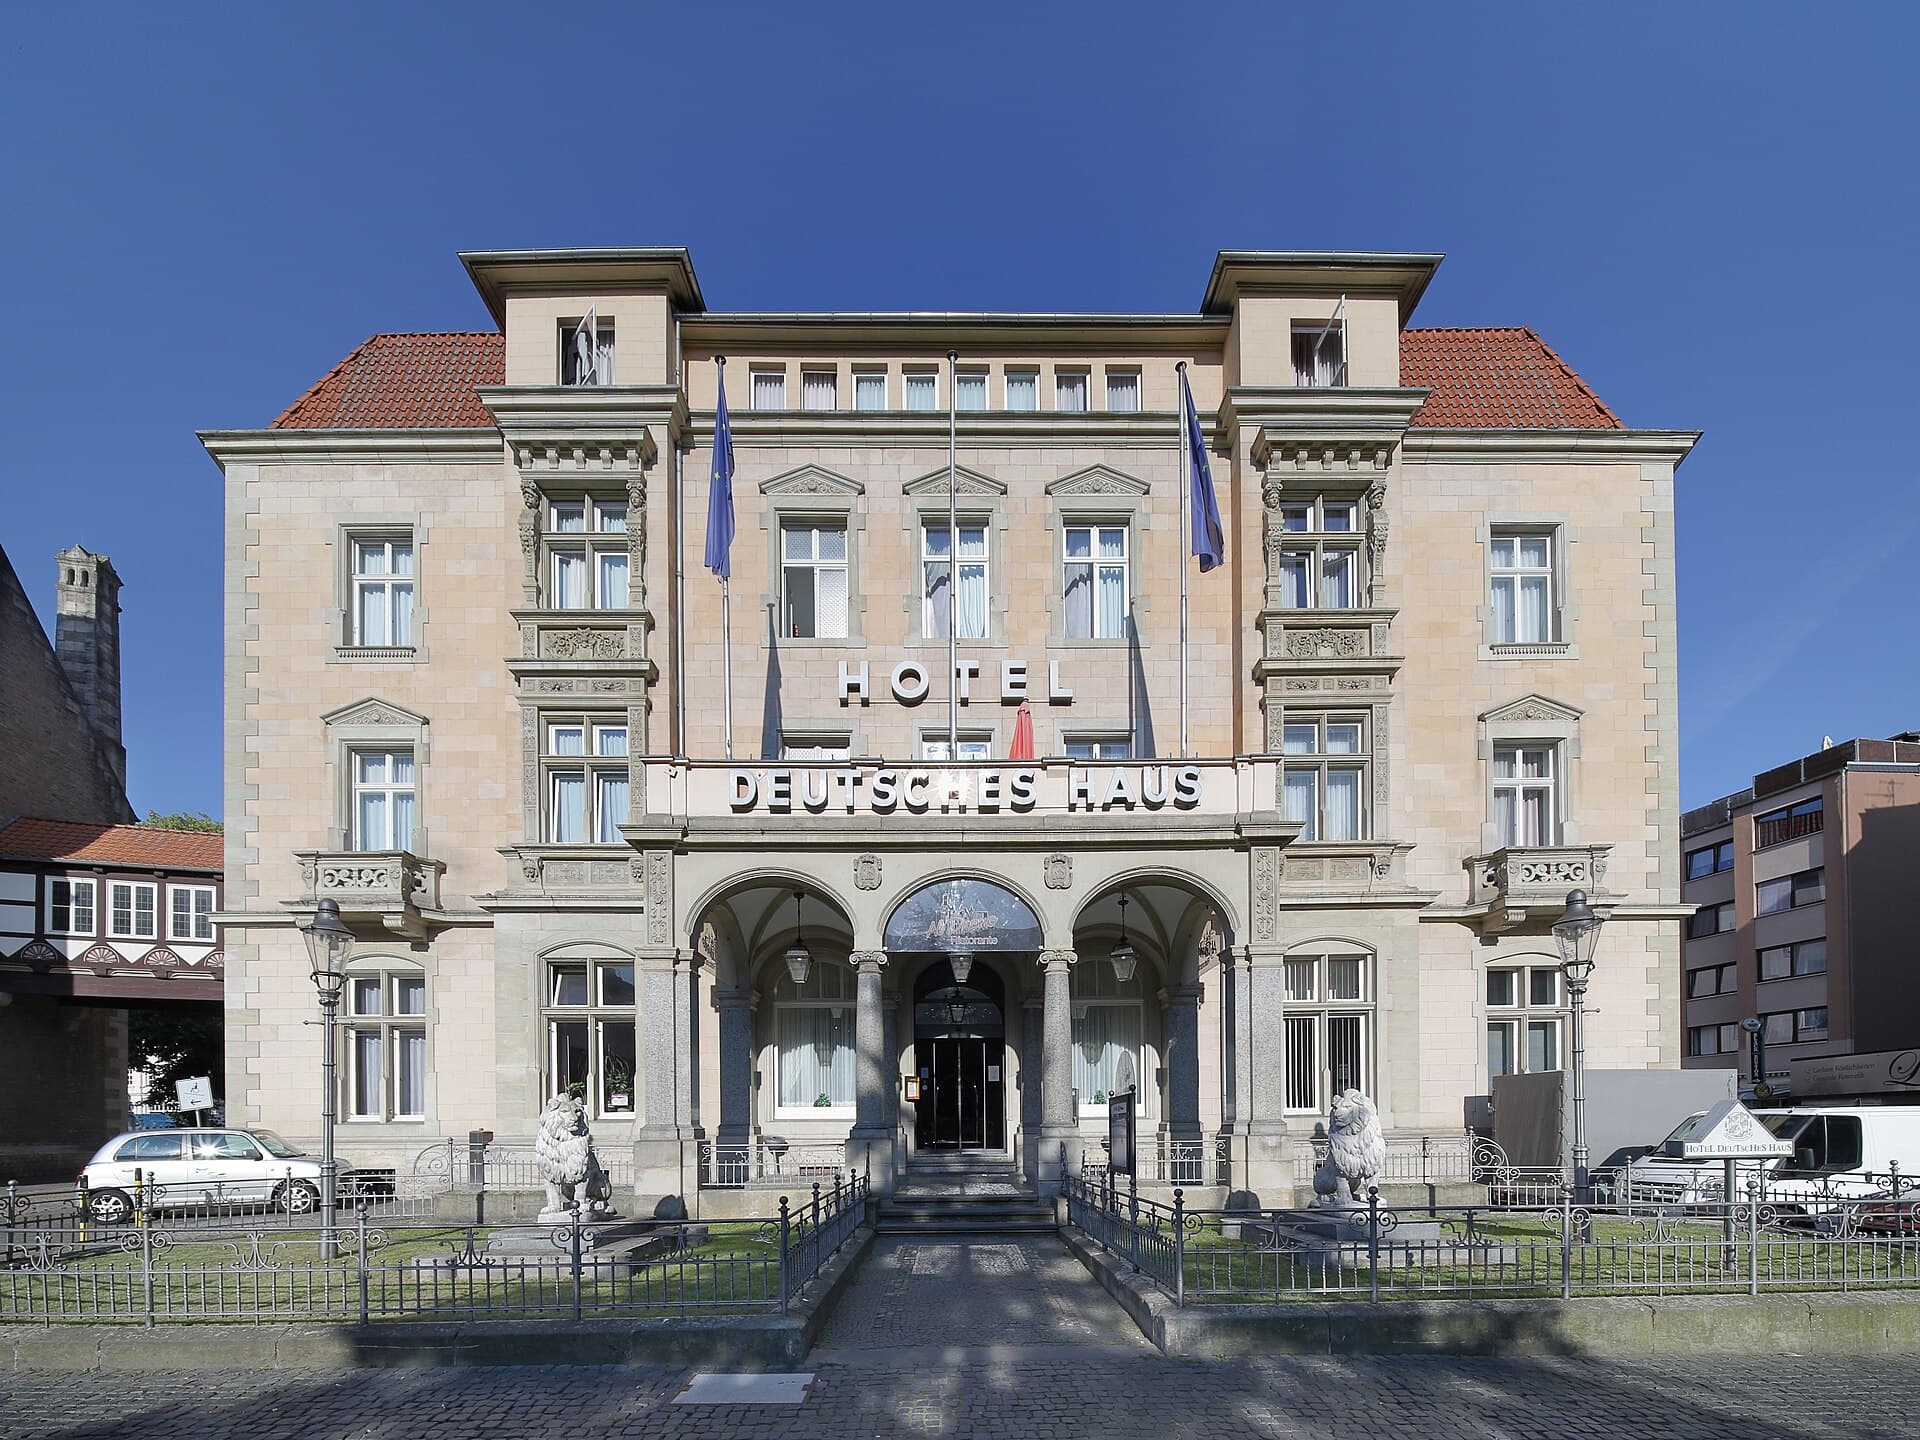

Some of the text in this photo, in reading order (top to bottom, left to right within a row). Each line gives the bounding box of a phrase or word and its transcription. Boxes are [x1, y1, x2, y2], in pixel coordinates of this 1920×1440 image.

[838, 659, 1073, 706] HOTEL
[729, 765, 1201, 814] DEUTSCHES HAUS
[950, 935, 999, 945] Ristorante
[1686, 1143, 1792, 1153] HOTEL DEUTSCHES HAUS
